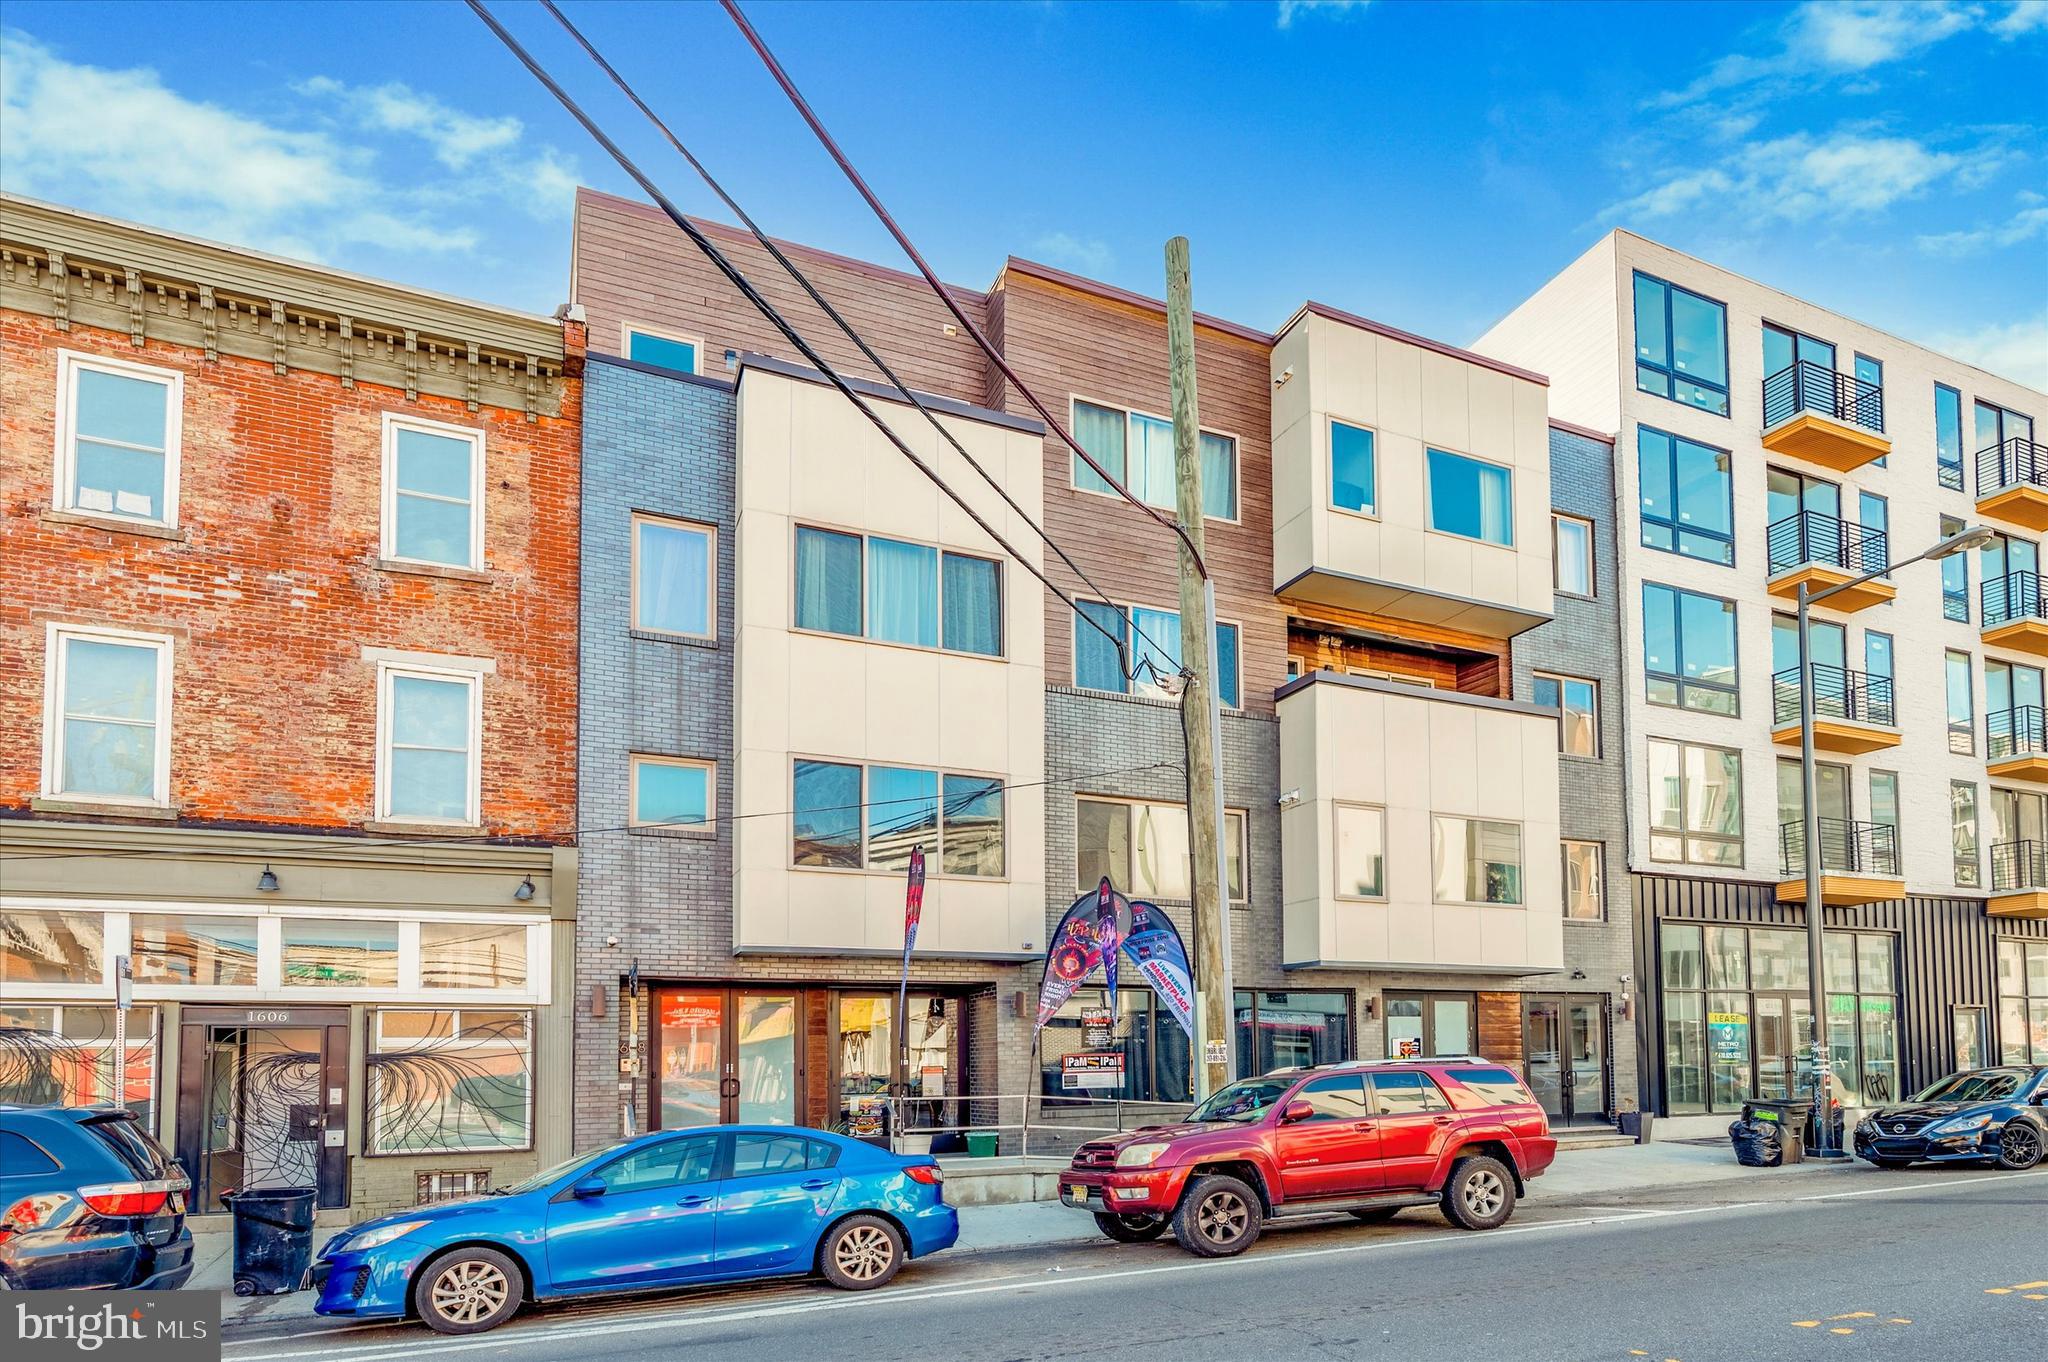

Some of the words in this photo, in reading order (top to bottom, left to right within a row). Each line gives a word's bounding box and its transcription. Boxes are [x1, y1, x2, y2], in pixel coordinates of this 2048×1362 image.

[1046, 981, 1065, 989] EVERY
[1142, 965, 1165, 991] VENDORS
[1148, 961, 1191, 1012] MARKETPLACE
[1157, 961, 1170, 974] LIVE
[1168, 973, 1187, 996] EVENTS
[1045, 986, 1066, 995] FRIDAY
[247, 1011, 287, 1022] 1606
